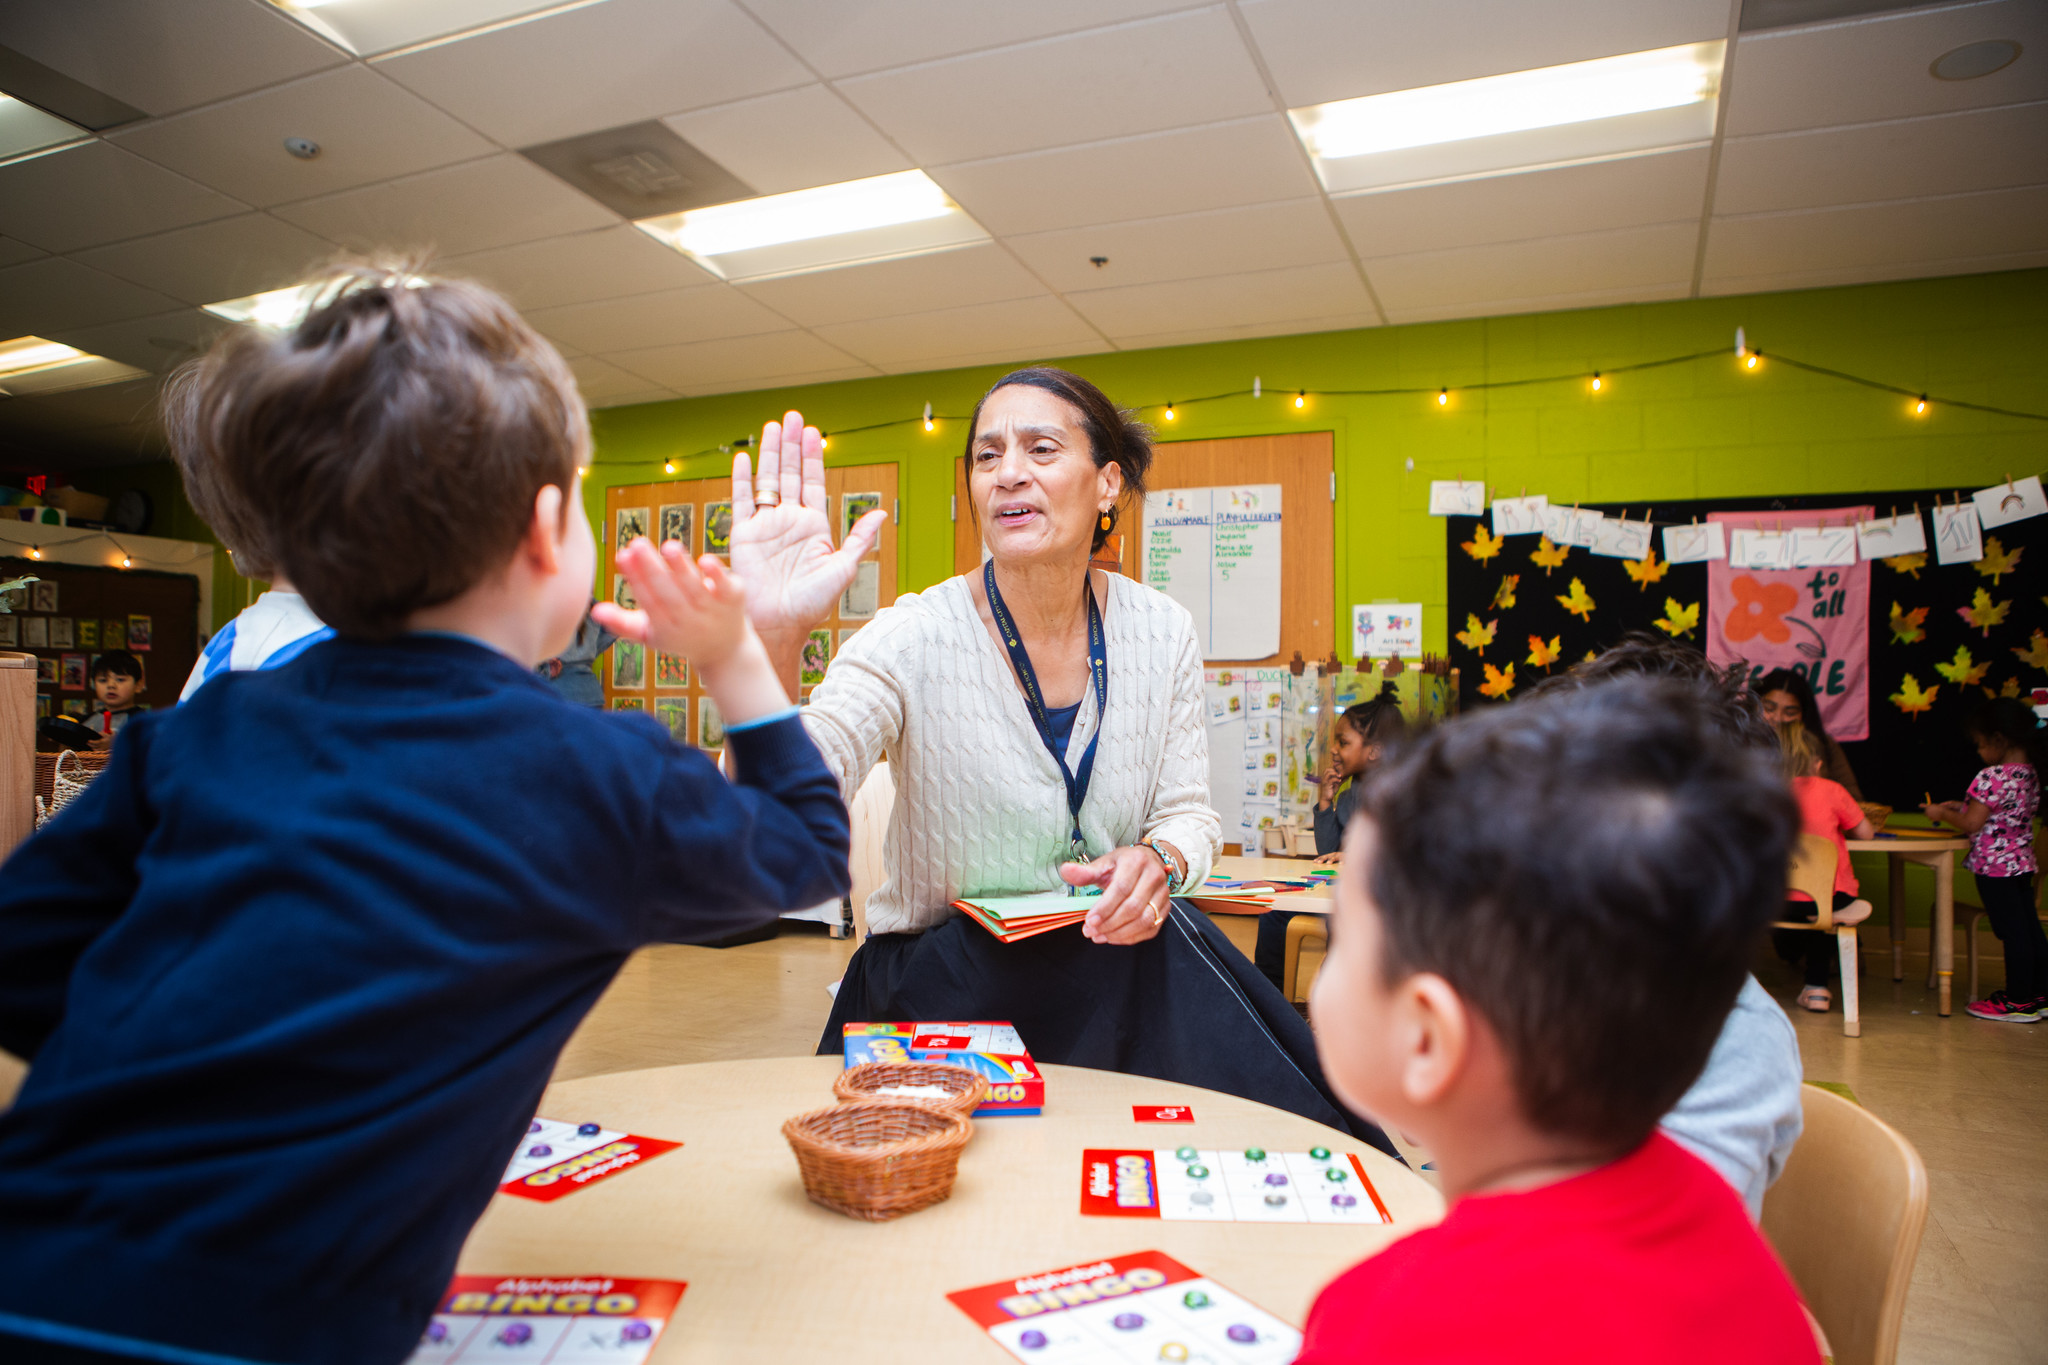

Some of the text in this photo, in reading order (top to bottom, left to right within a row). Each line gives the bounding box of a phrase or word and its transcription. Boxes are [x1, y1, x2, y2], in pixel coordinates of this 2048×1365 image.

[1222, 569, 1230, 581] 5
[1806, 570, 1840, 599] to
[1812, 589, 1846, 618] all
[523, 1141, 640, 1187] BINGO
[1115, 1154, 1156, 1208] BINGO
[496, 1278, 615, 1294] Alphabet
[998, 1267, 1167, 1320] BINGO
[443, 1292, 640, 1315] BINGO
